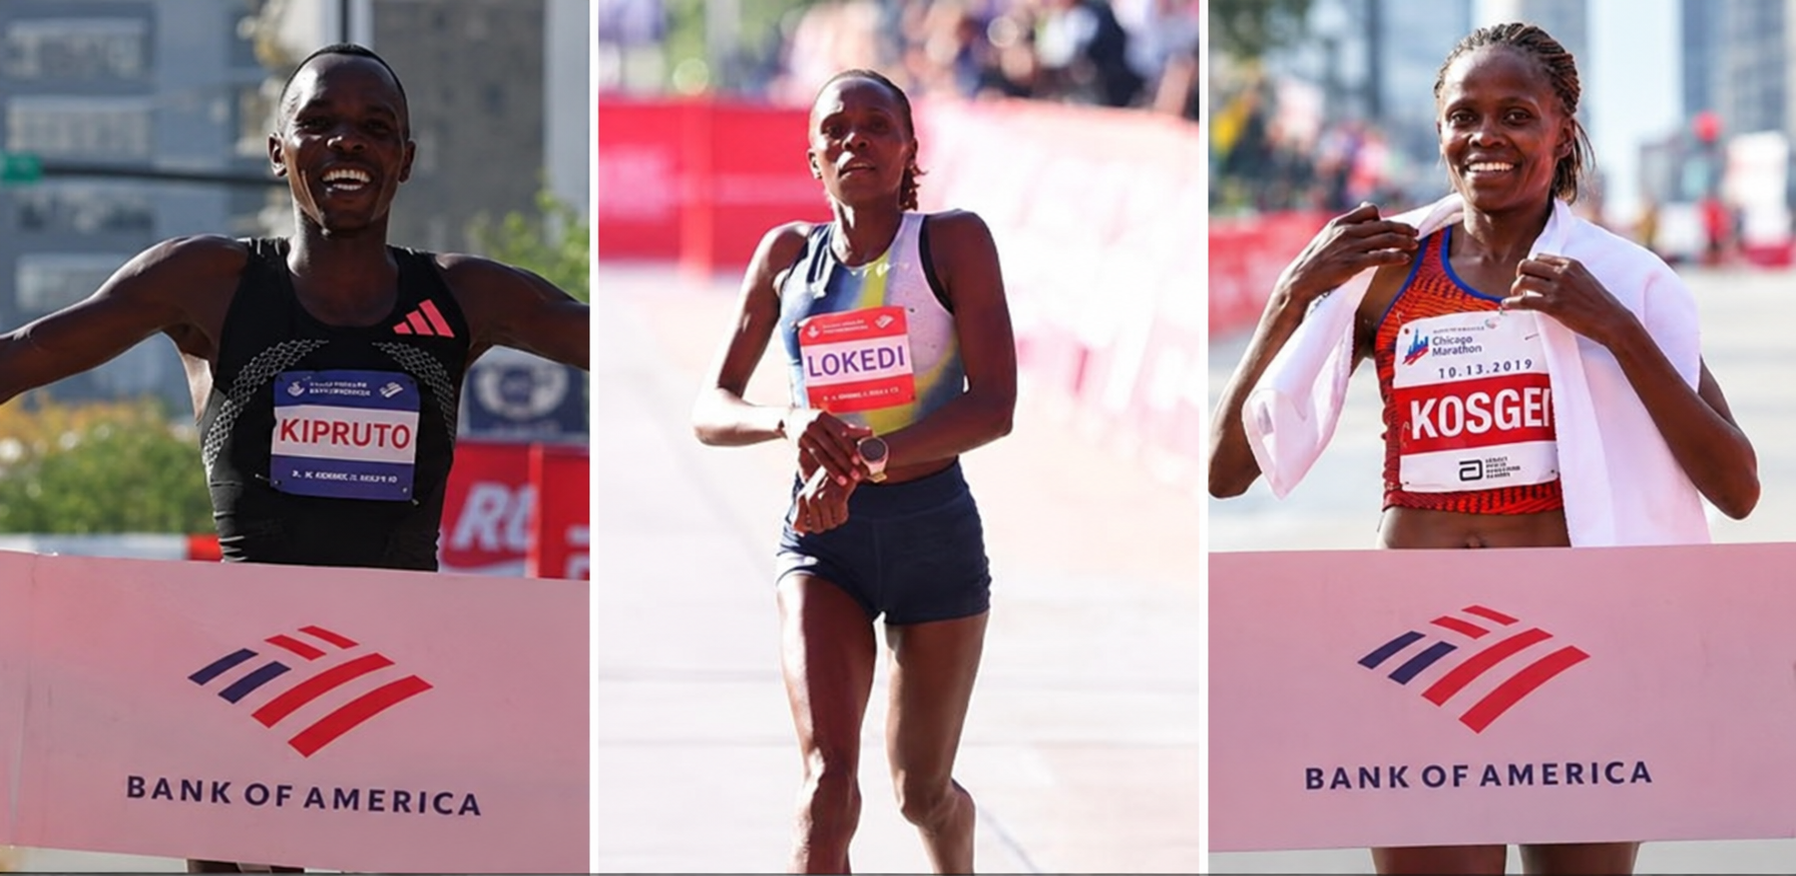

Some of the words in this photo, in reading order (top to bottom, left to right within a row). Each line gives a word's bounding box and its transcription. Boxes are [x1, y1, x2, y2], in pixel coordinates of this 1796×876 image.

[1432, 335, 1473, 346] Chicago
[1432, 345, 1482, 357] Marathon
[808, 345, 905, 378] LOKEDI
[1439, 359, 1532, 379] 10.13.2019
[280, 418, 411, 449] KIPRUTO
[1305, 765, 1410, 790] BANK
[1422, 764, 1469, 788] OF
[1480, 761, 1652, 788] AMERICA
[126, 775, 232, 804] BANK
[244, 782, 293, 807] OF
[303, 786, 481, 817] AMERICA
